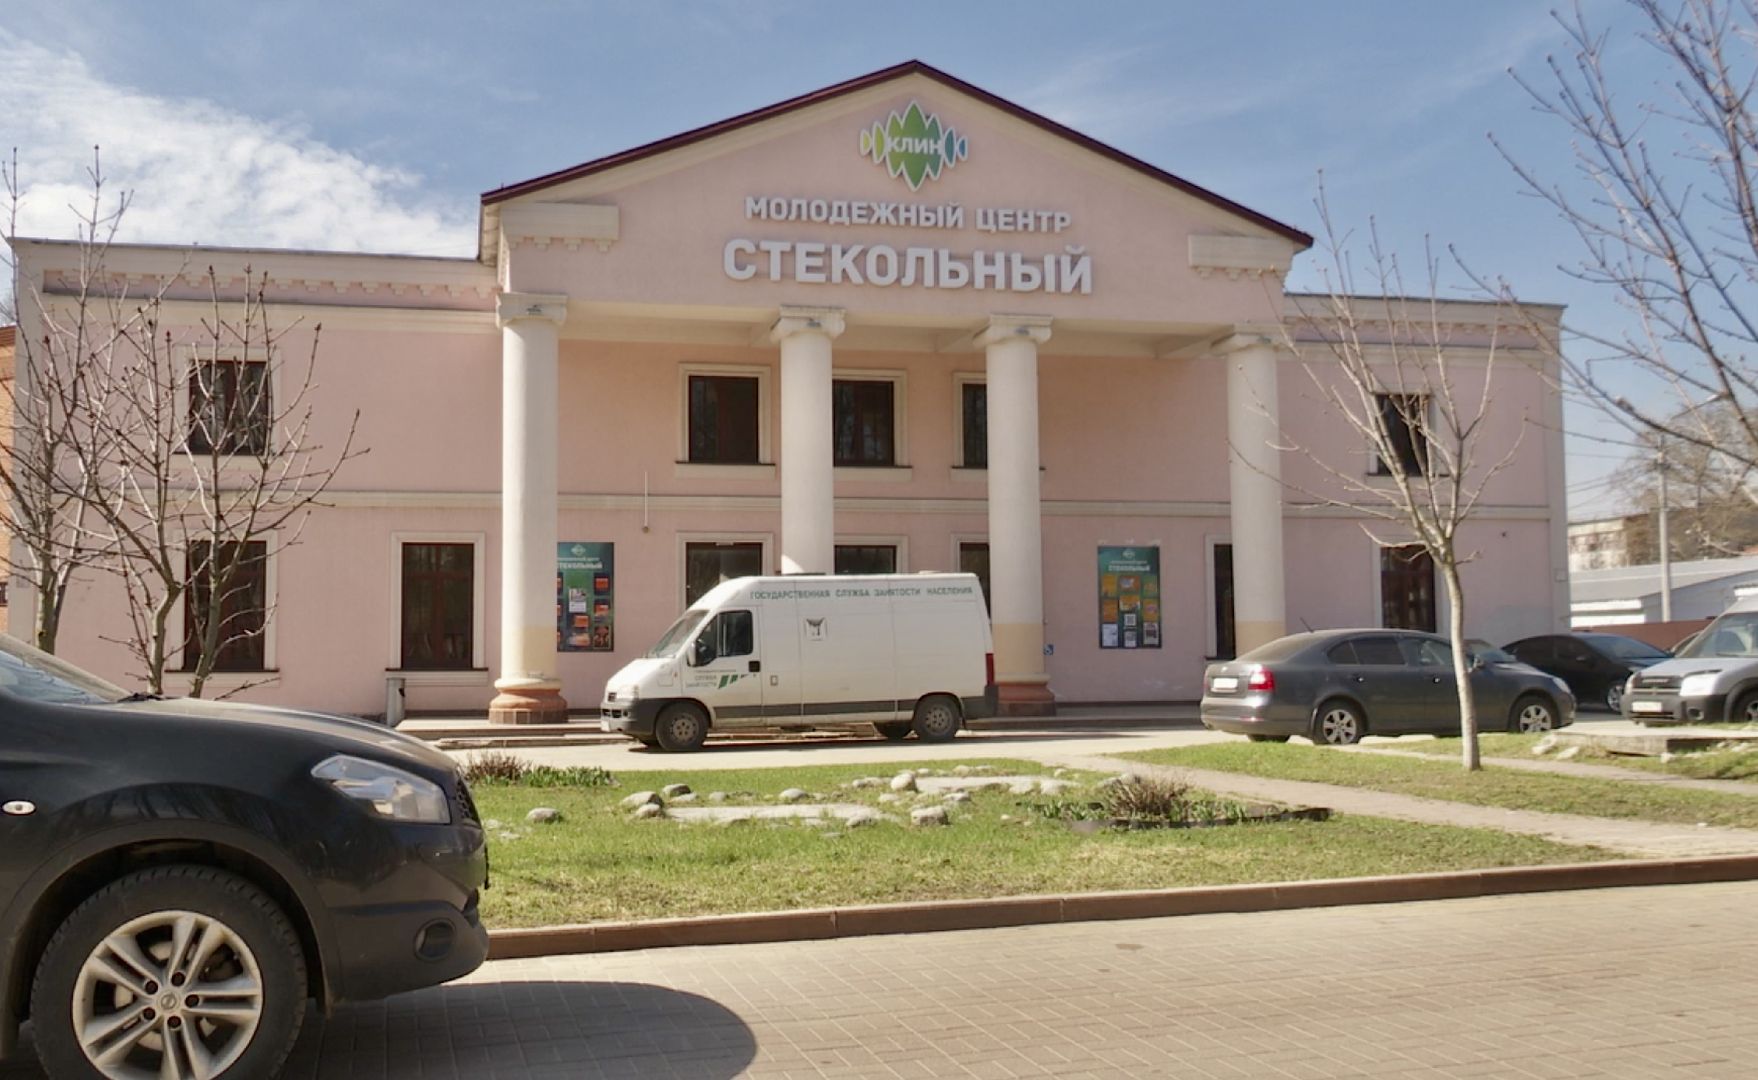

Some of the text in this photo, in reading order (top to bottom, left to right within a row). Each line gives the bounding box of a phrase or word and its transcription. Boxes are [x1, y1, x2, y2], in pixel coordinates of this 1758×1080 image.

[887, 136, 941, 155] КЛИН
[745, 196, 1072, 234] МОЛОДЕЖНЫЙ ЦЕНТР
[723, 238, 1093, 295] СТЕКОЛЬНЫЙ
[750, 590, 831, 600] ГОСУДАРСТВЕННАЯ
[835, 589, 870, 598] СЛУЖБА
[926, 586, 973, 596] НАСЕЛЕНИЯ
